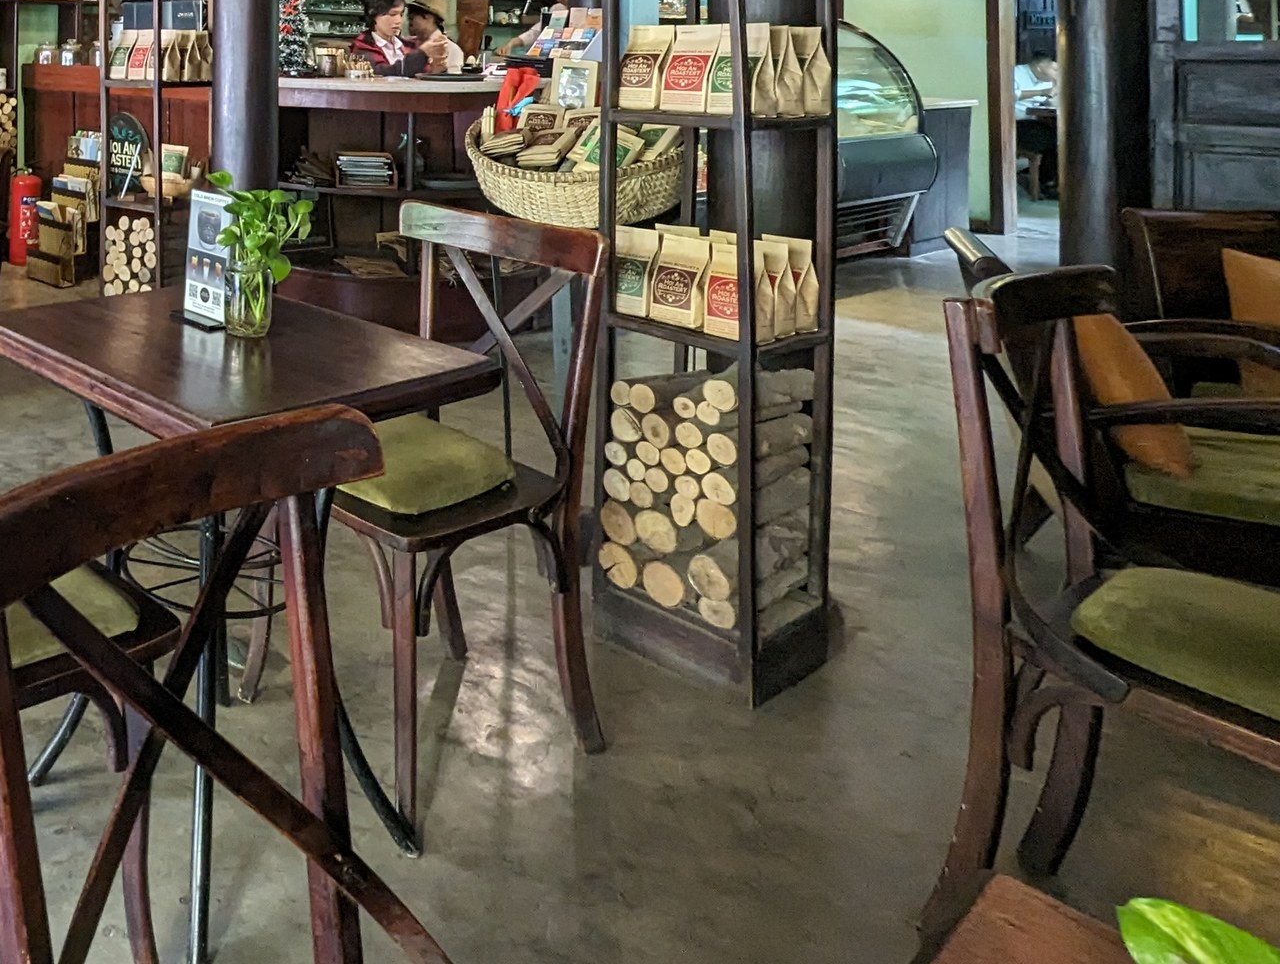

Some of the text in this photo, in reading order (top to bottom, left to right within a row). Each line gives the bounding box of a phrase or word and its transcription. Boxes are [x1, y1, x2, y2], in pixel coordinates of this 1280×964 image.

[110, 140, 136, 155] OI AN
[658, 282, 688, 293] ROASTERY
[711, 293, 738, 303] ROASTE
